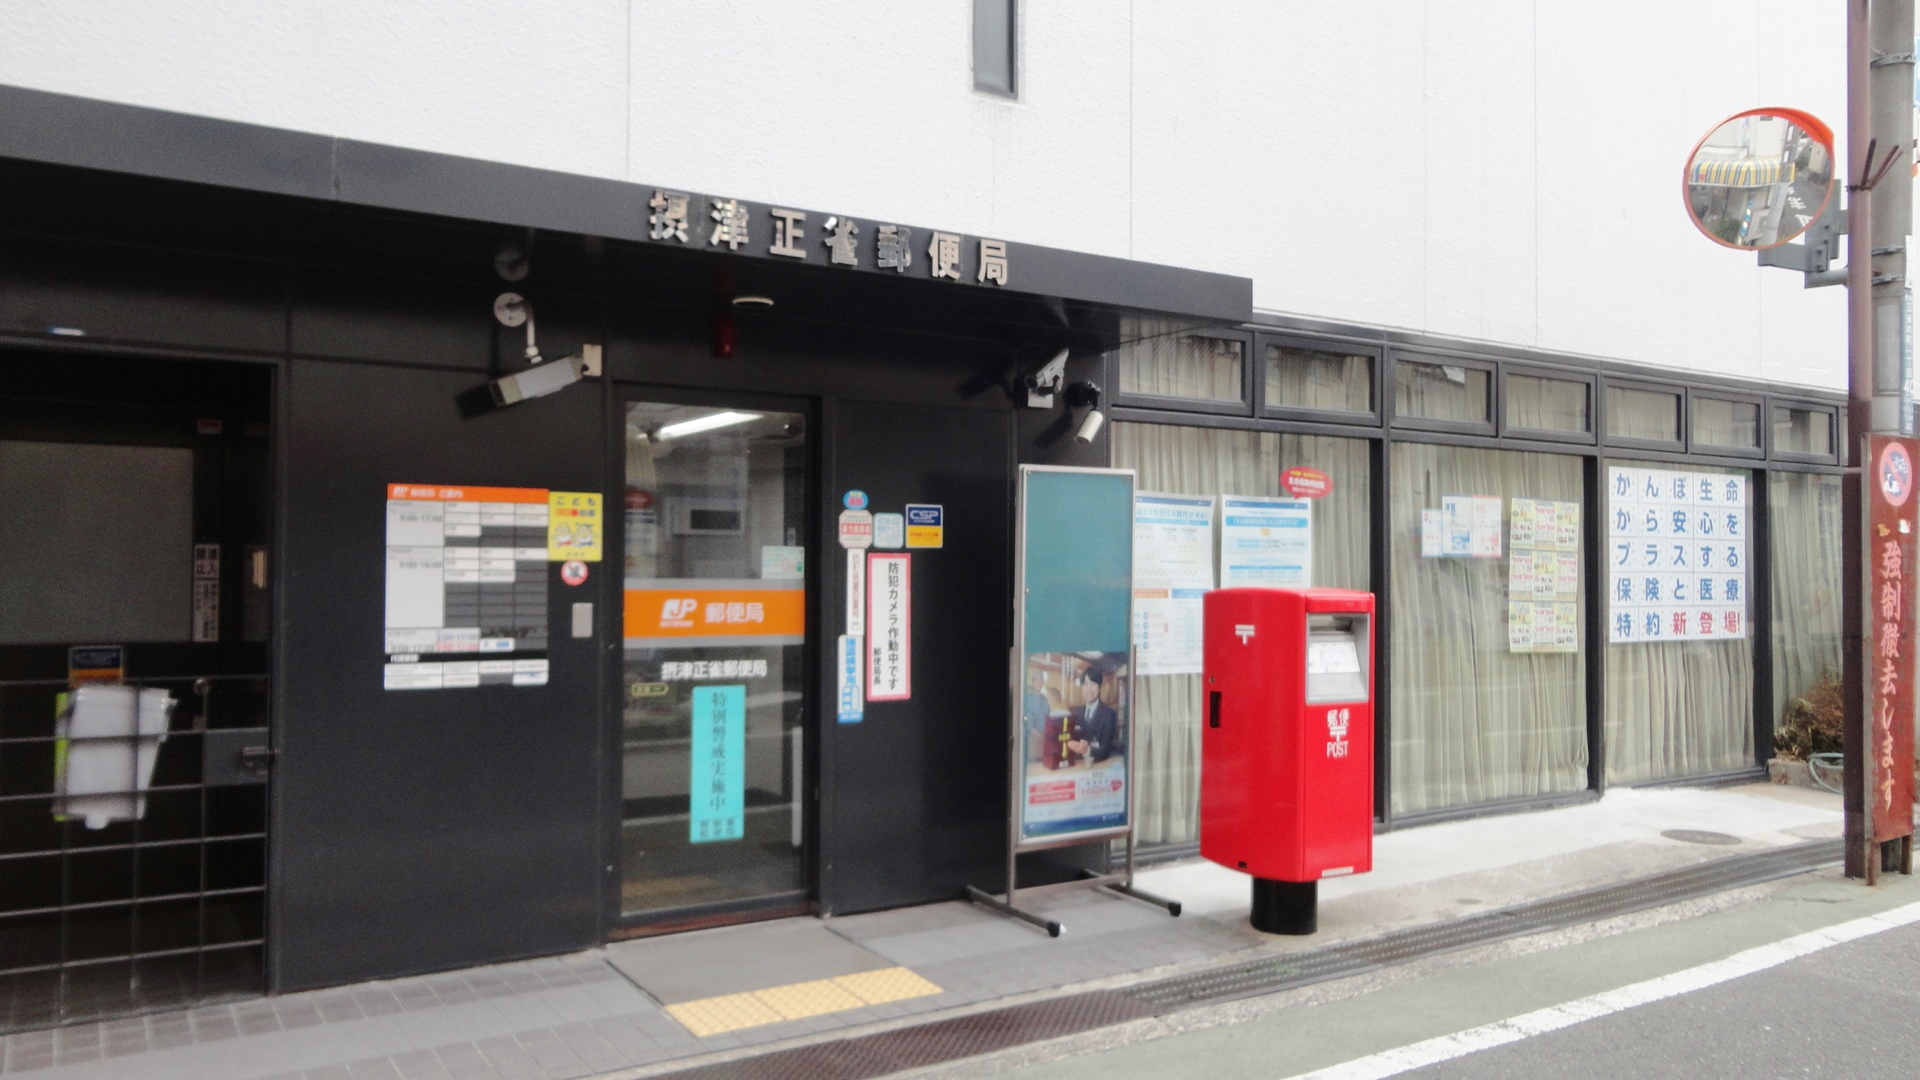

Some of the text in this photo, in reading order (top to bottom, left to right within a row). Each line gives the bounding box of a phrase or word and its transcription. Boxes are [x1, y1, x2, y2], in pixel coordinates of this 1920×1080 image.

[649, 189, 1008, 286] 摂津正雀郵便局
[1616, 473, 1739, 503] かんぽ生命
[909, 510, 939, 520] CSP
[1616, 508, 1738, 535] から安心を
[1616, 542, 1739, 568] プラスする
[1616, 577, 1739, 601] 保険と医療
[705, 602, 764, 623] 郵便局
[888, 562, 899, 690] 防犯カメラ作動中です
[661, 660, 767, 681] 摂津正雀郵便局
[1327, 708, 1350, 727] 郵便
[1326, 741, 1349, 758] POST
